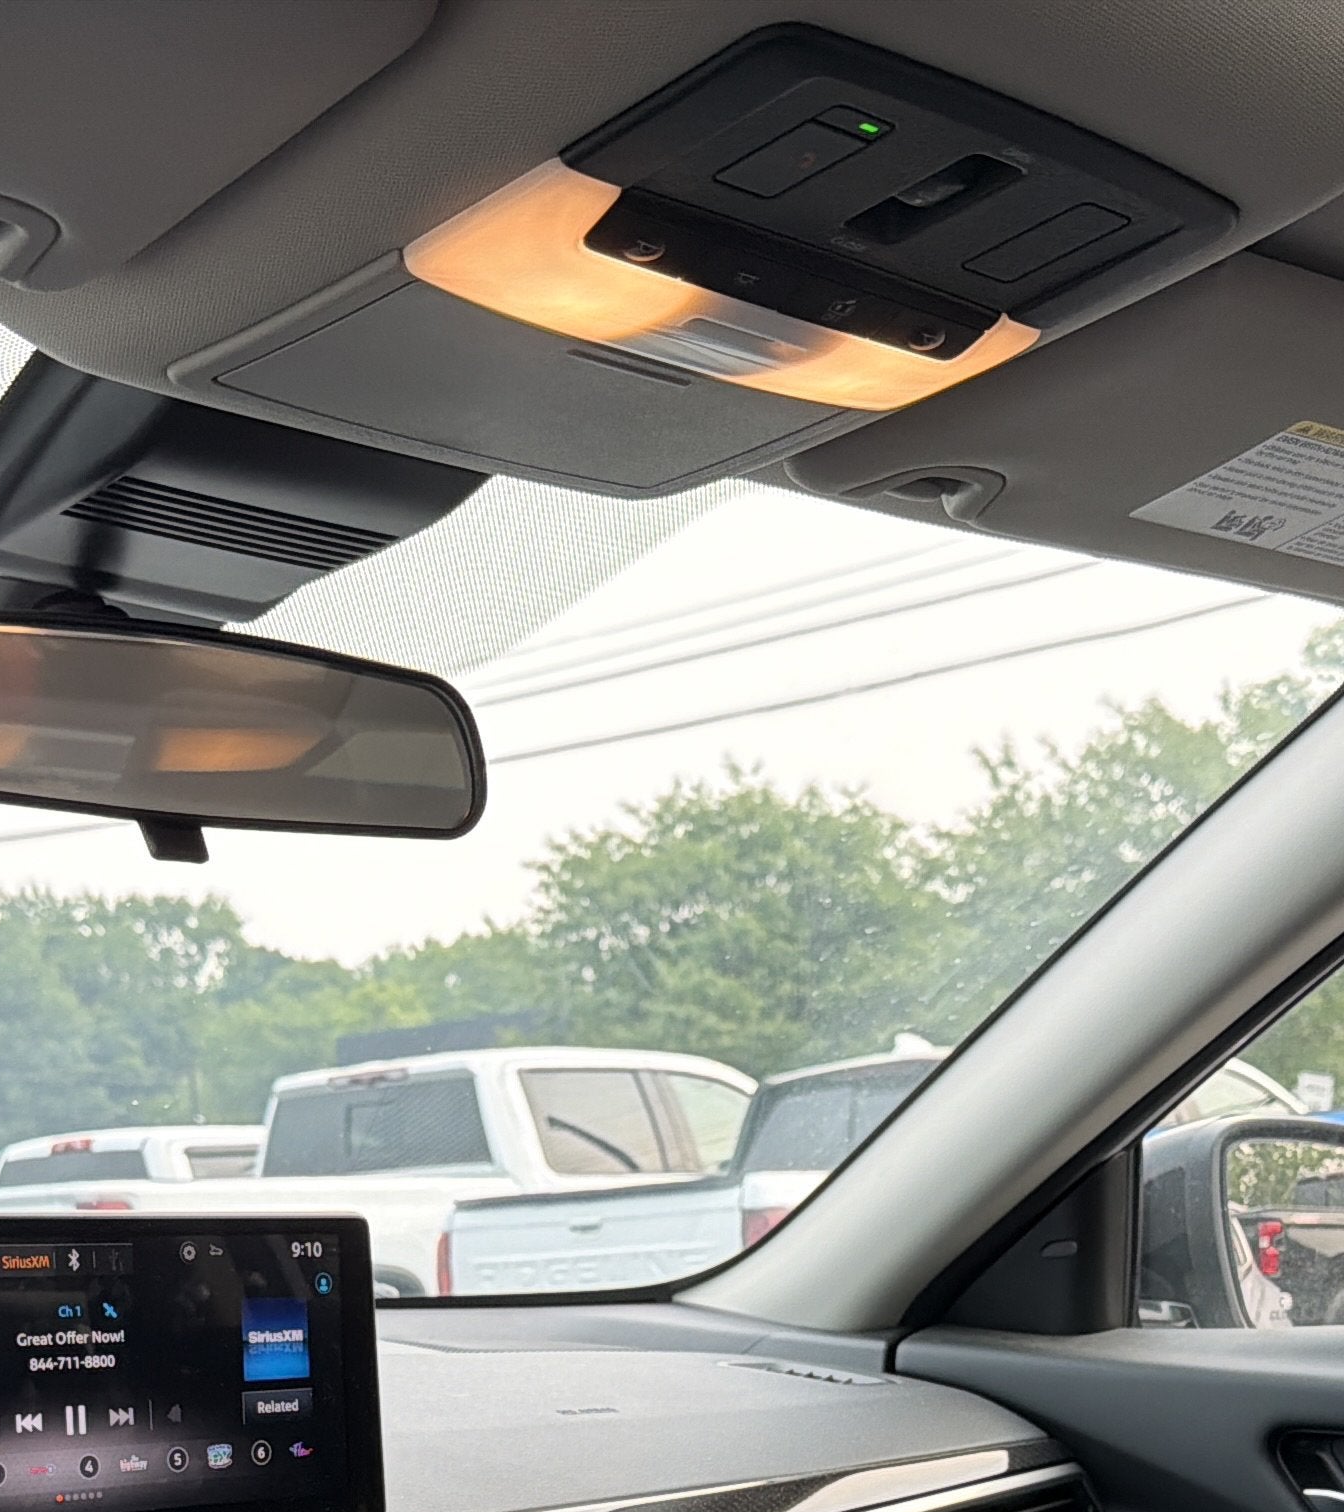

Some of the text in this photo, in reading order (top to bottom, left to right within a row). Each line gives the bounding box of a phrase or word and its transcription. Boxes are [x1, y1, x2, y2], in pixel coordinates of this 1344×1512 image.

[291, 1241, 323, 1258] 9:10
[1, 1255, 50, 1270] SiriusXM
[58, 1305, 81, 1317] Ch 1
[16, 1329, 125, 1347] Great Offer Now!
[248, 1329, 304, 1344] SiriusXM
[29, 1354, 116, 1372] 844-711-8800
[257, 1399, 300, 1414] Related
[173, 1453, 182, 1466] 5
[257, 1446, 266, 1460] 6
[84, 1460, 94, 1474] 4
